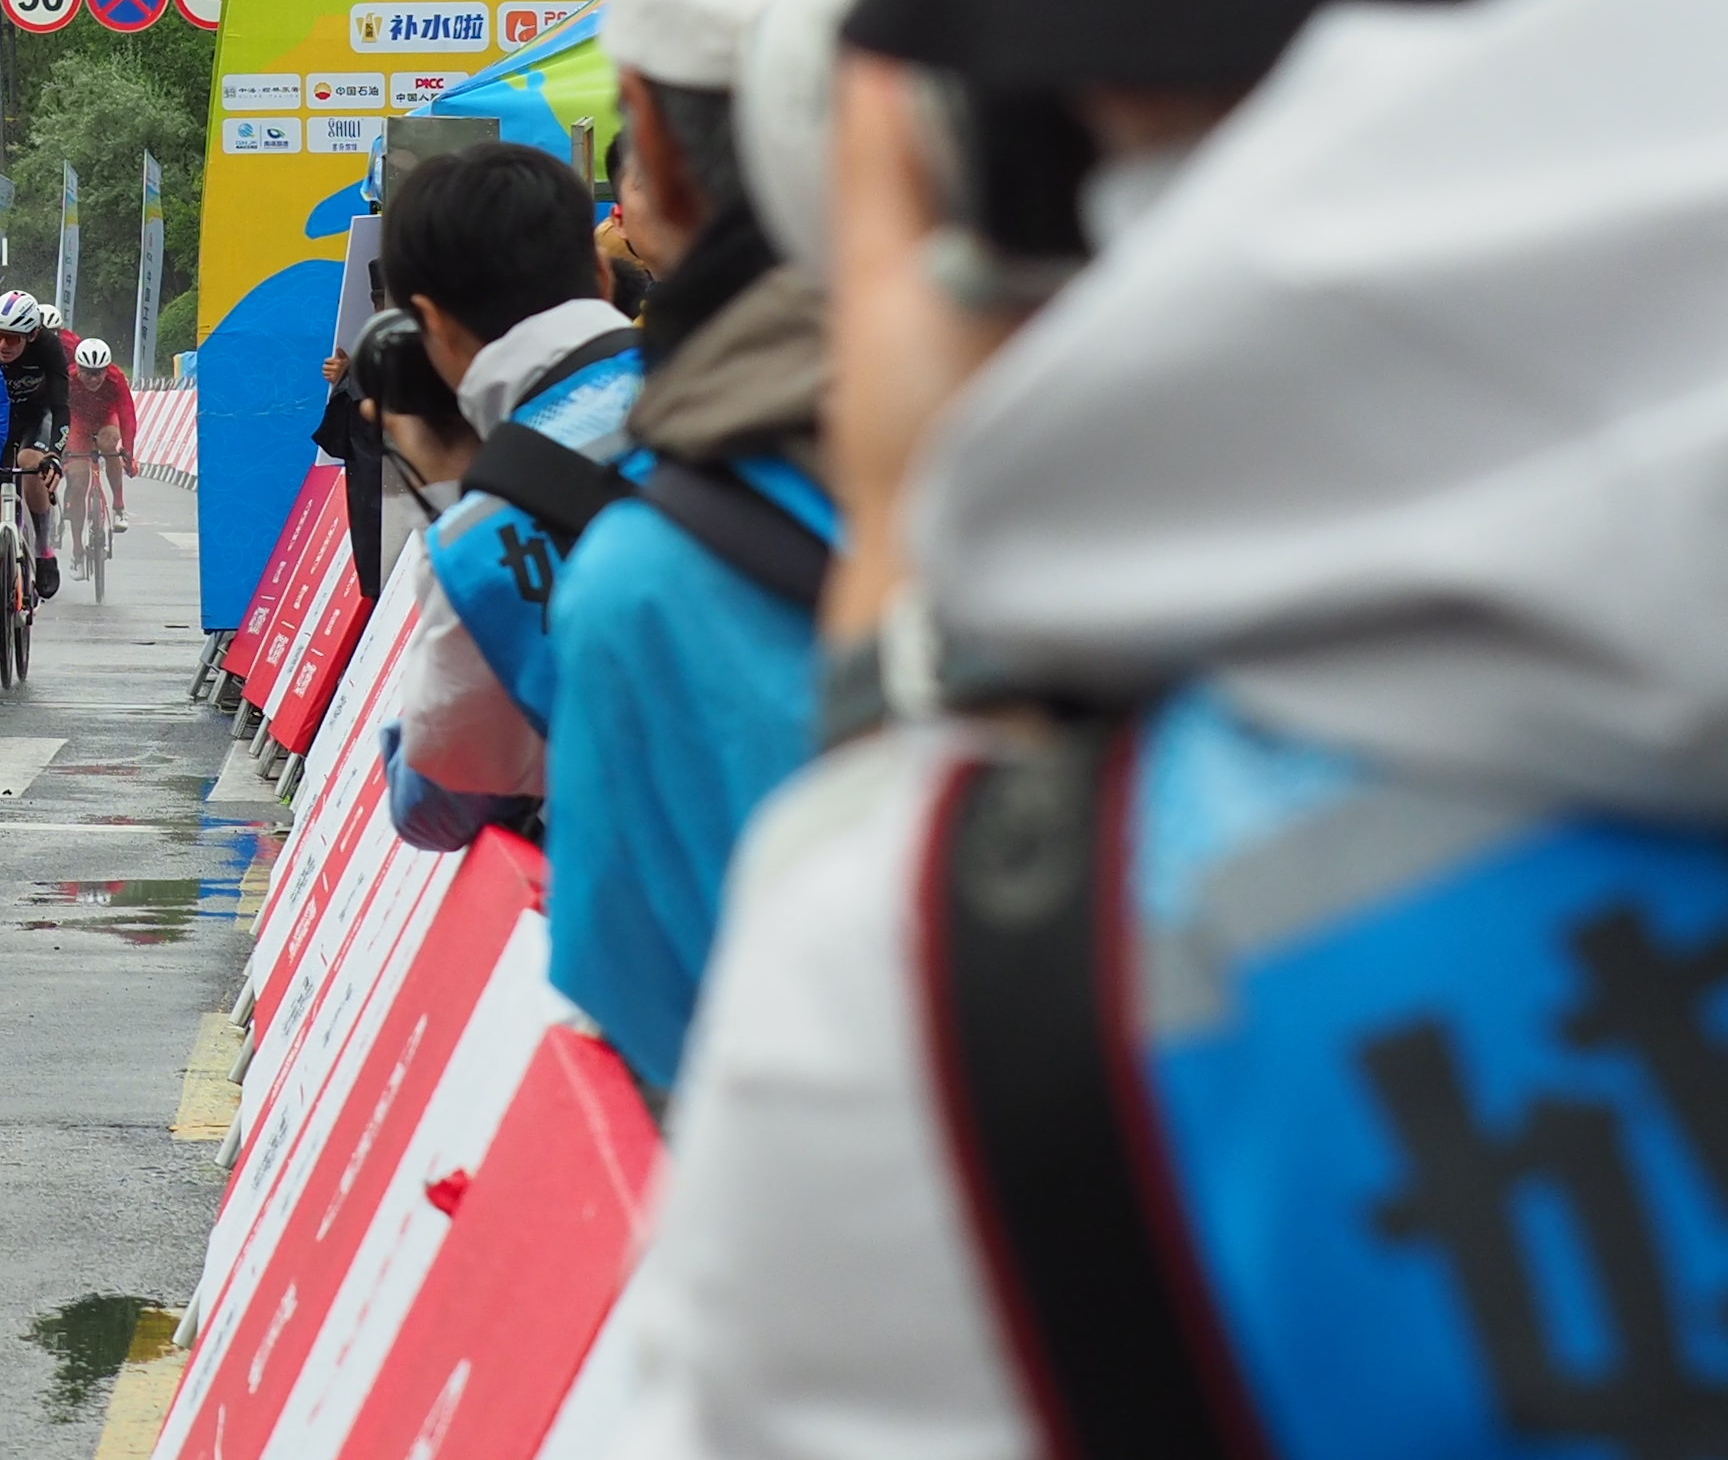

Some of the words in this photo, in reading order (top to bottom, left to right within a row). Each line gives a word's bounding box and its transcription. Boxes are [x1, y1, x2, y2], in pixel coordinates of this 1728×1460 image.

[389, 14, 484, 41] 补水啦
[415, 78, 444, 89] PICC
[336, 86, 379, 97] 中国石油
